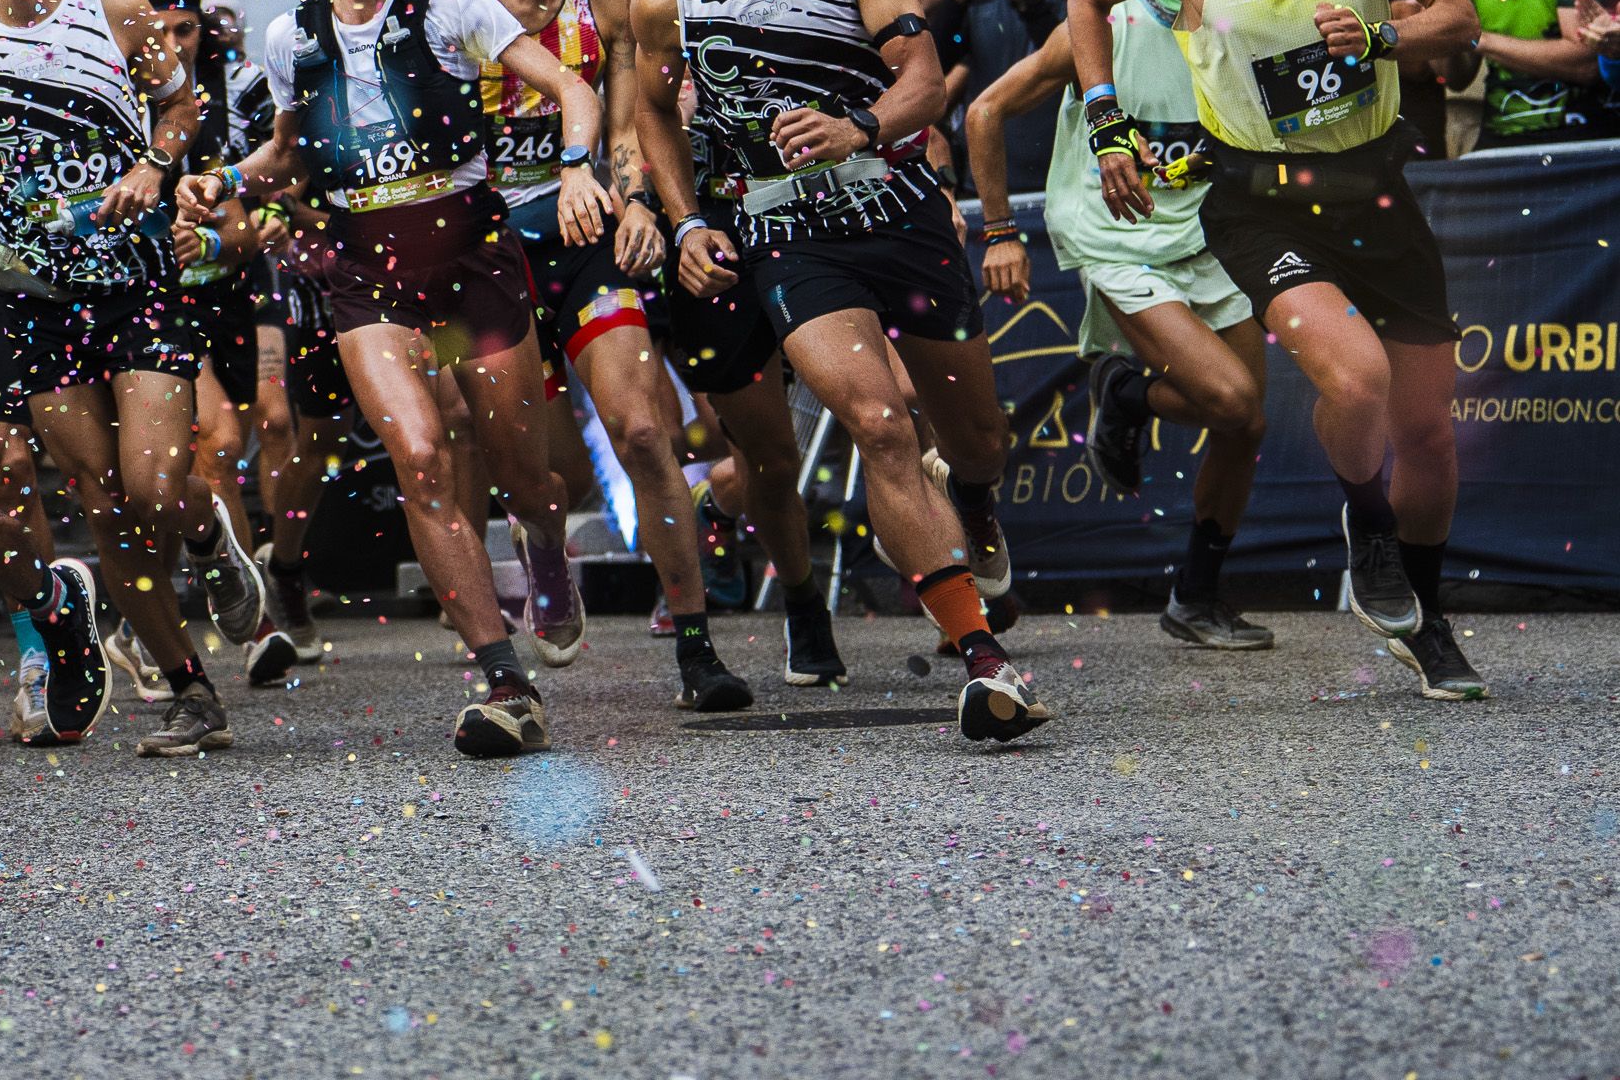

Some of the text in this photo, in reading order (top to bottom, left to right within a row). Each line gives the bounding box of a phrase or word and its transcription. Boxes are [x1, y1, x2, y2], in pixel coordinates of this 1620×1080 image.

[1297, 61, 1342, 102] 96
[1311, 91, 1340, 107] ANDRÉS
[359, 140, 415, 179] 169
[495, 133, 554, 162] 246
[34, 153, 108, 194] 309
[378, 171, 408, 184] OIHANA
[775, 284, 793, 323] SALOMON
[1504, 322, 1618, 373] URBI
[1449, 396, 1620, 424] AFIOURBION.C
